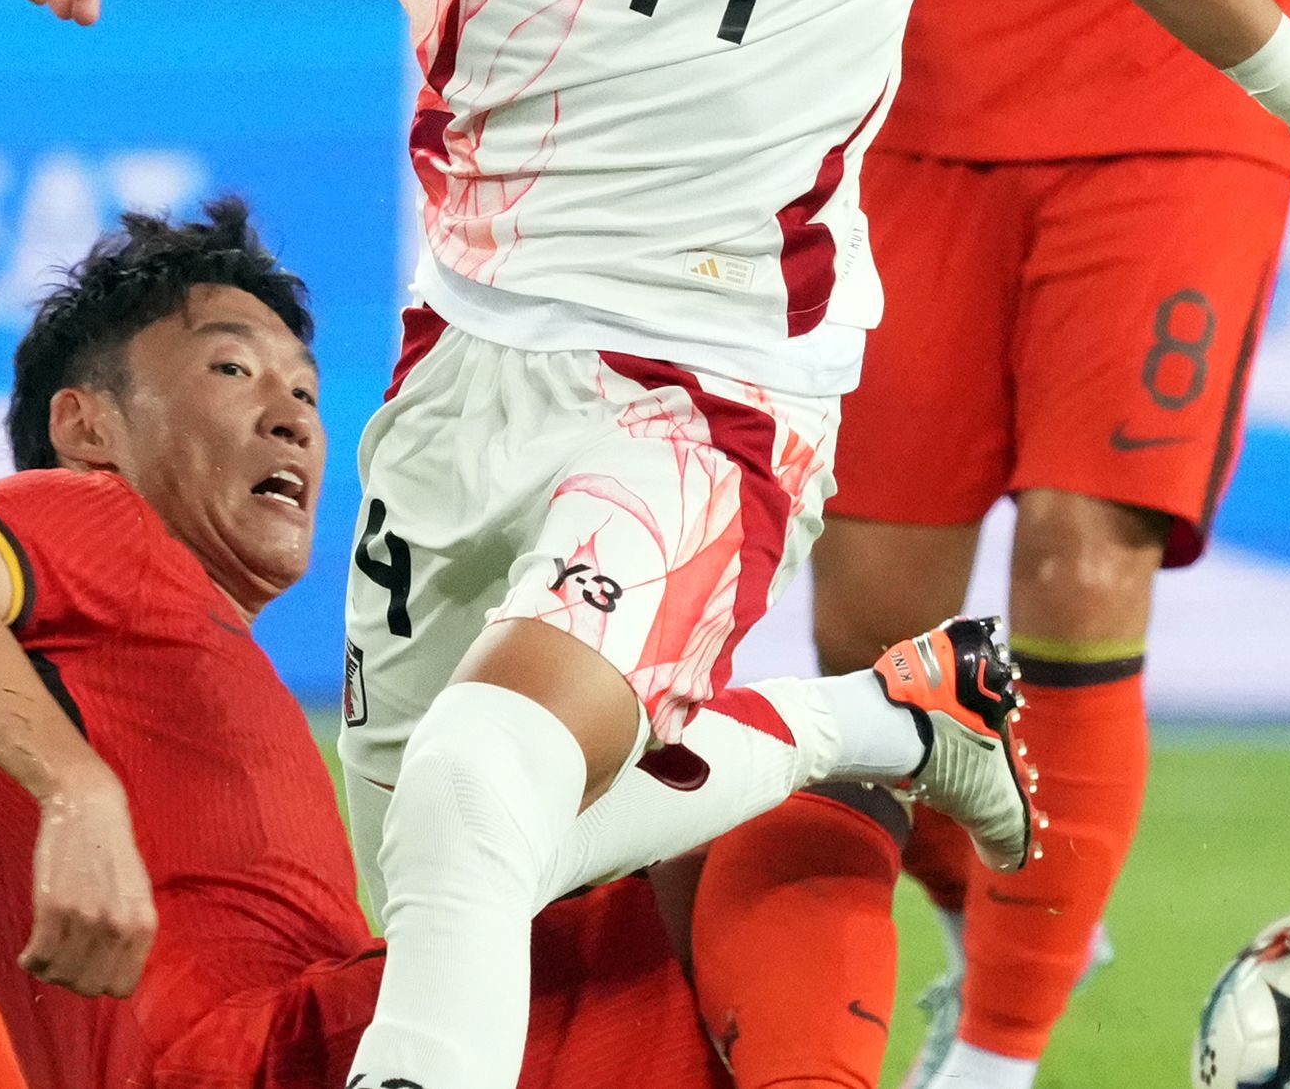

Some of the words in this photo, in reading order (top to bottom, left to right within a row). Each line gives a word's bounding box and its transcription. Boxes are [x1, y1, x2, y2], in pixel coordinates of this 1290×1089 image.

[1143, 287, 1218, 411] 8
[354, 498, 412, 639] 4
[549, 557, 623, 613] Y-3
